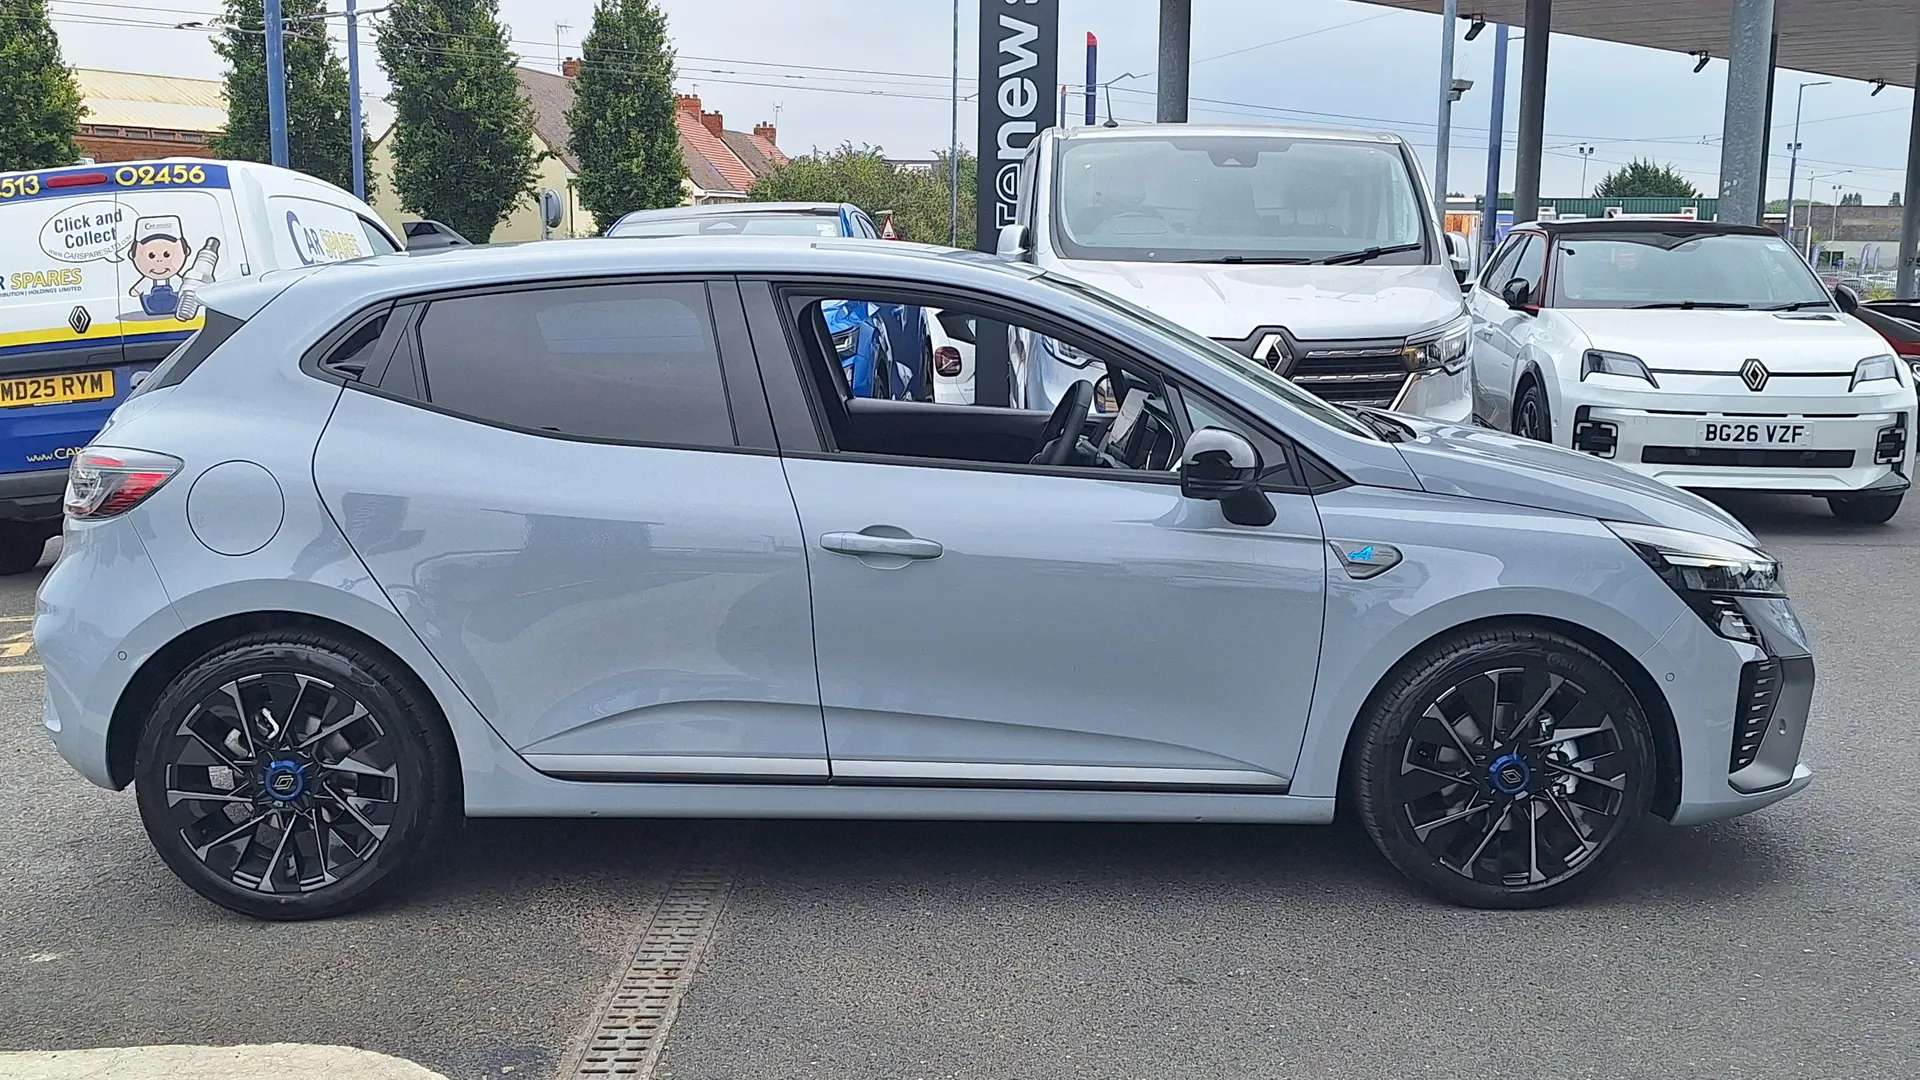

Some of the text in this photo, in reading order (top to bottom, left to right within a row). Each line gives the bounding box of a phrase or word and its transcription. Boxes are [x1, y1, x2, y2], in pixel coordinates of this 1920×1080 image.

[54, 214, 92, 234] Click
[95, 208, 123, 227] and
[65, 227, 117, 249] Collect
[10, 268, 82, 290] SPARES
[0, 373, 103, 401] MD25 RYM
[1705, 424, 1805, 443] BG26 VZF
